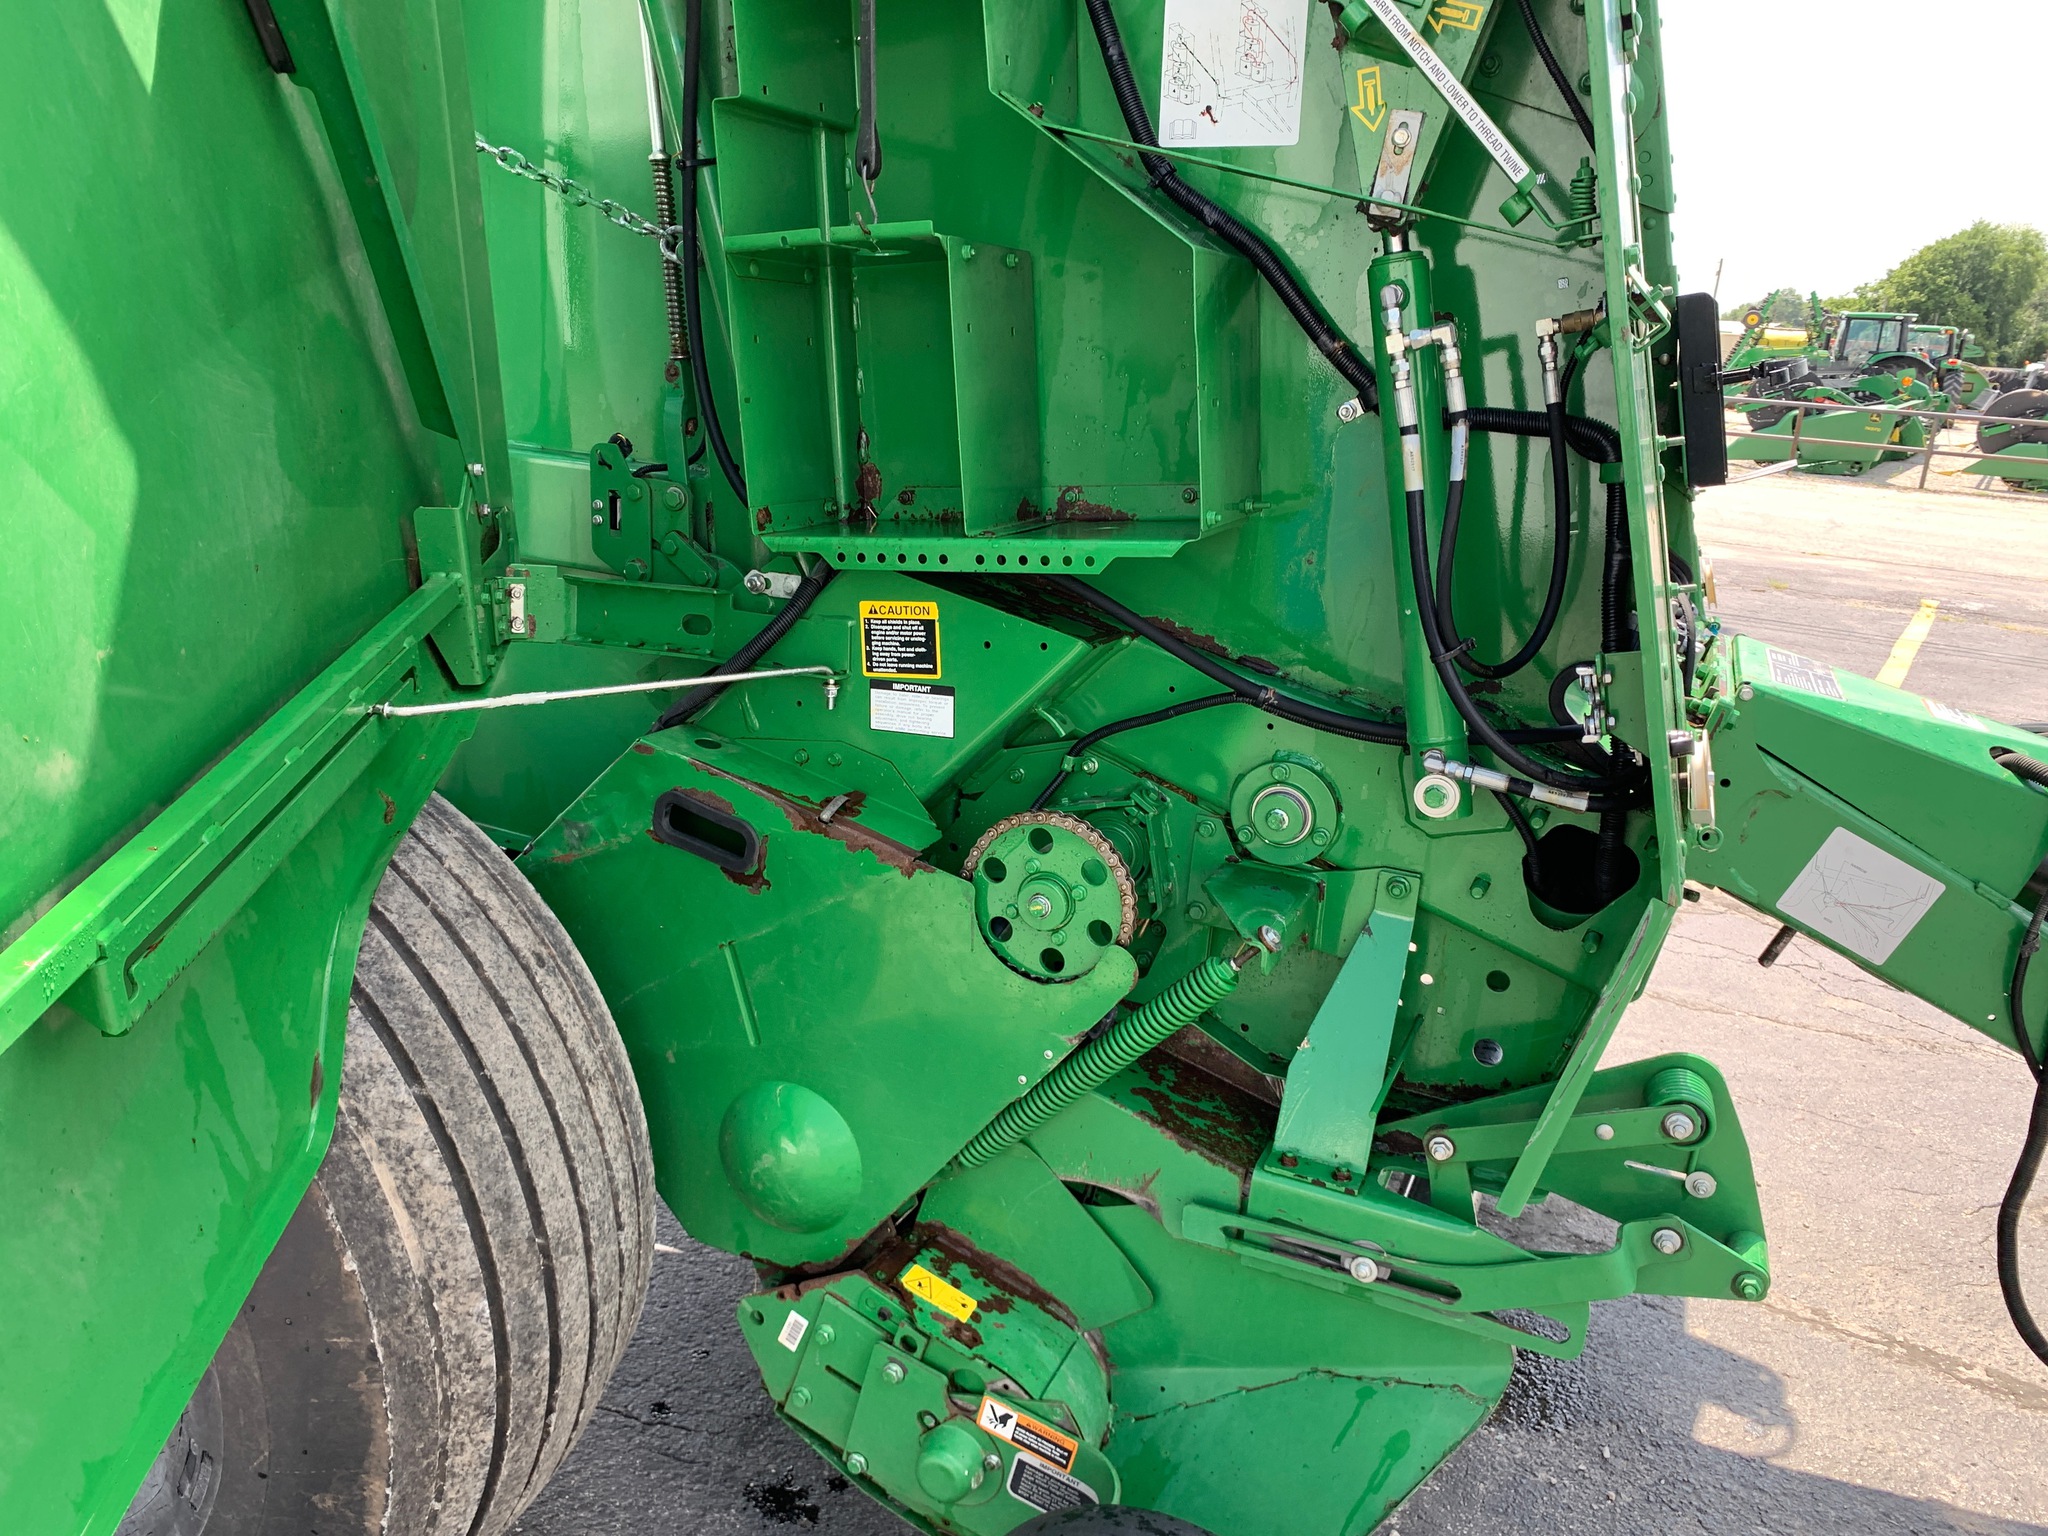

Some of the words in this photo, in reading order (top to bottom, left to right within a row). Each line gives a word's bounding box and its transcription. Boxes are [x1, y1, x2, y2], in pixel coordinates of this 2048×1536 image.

[1373, 0, 1393, 17] ARM
[1389, 11, 1410, 41] FROM
[1407, 34, 1433, 66] NOTCH
[1429, 62, 1447, 83] AND
[1443, 79, 1469, 111] LOWER
[1465, 105, 1479, 122] TO
[1475, 116, 1503, 152] THREAD
[1500, 148, 1524, 178] TWINE
[879, 605, 930, 615] CAUTION
[892, 683, 931, 693] IMPORTANT
[1032, 1425, 1066, 1445] WARNING
[1039, 1462, 1081, 1487] IMPORTANT
